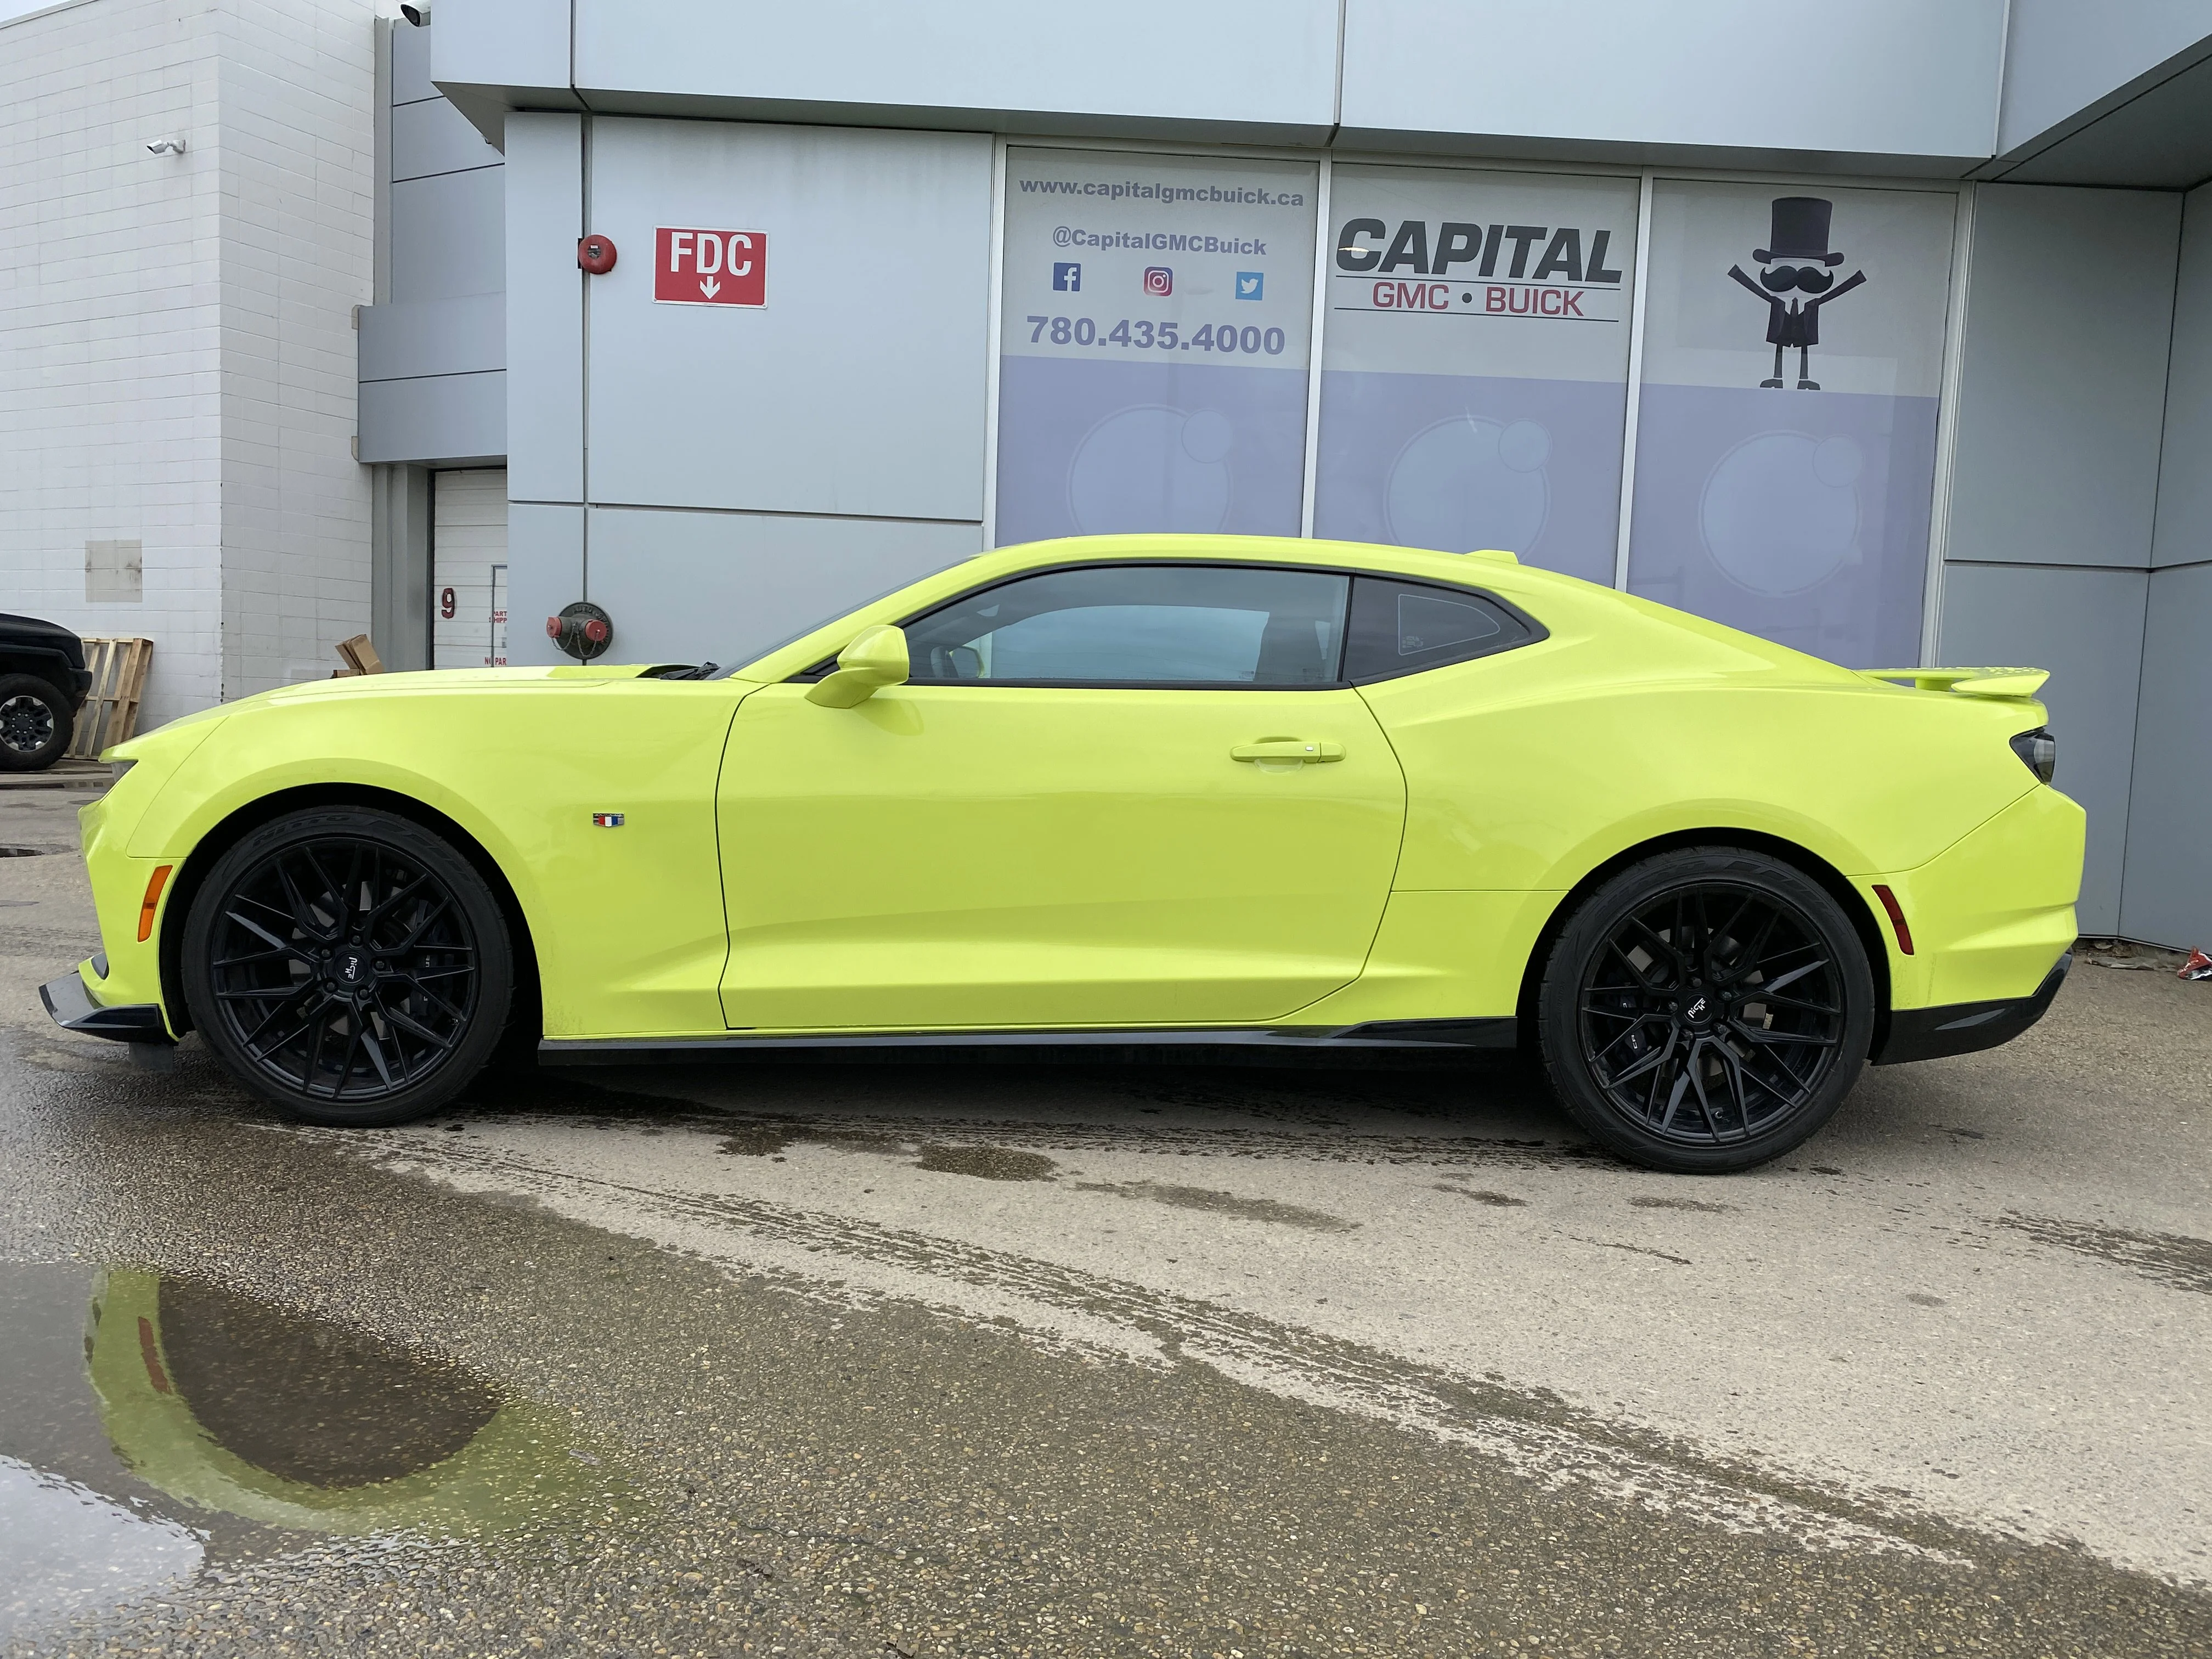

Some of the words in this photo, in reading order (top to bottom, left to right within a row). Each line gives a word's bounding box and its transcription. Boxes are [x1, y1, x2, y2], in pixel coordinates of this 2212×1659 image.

[1019, 179, 1304, 206] www.capitalgmcbuick.ca
[670, 232, 752, 276] FDC
[1052, 225, 1267, 255] @CapitalGMCBuick
[1335, 217, 1623, 284] CAPITAL
[1372, 281, 1449, 310] GMC
[1485, 286, 1584, 317] BUICK
[1026, 315, 1285, 356] 780.435.4000
[441, 588, 455, 619] 9
